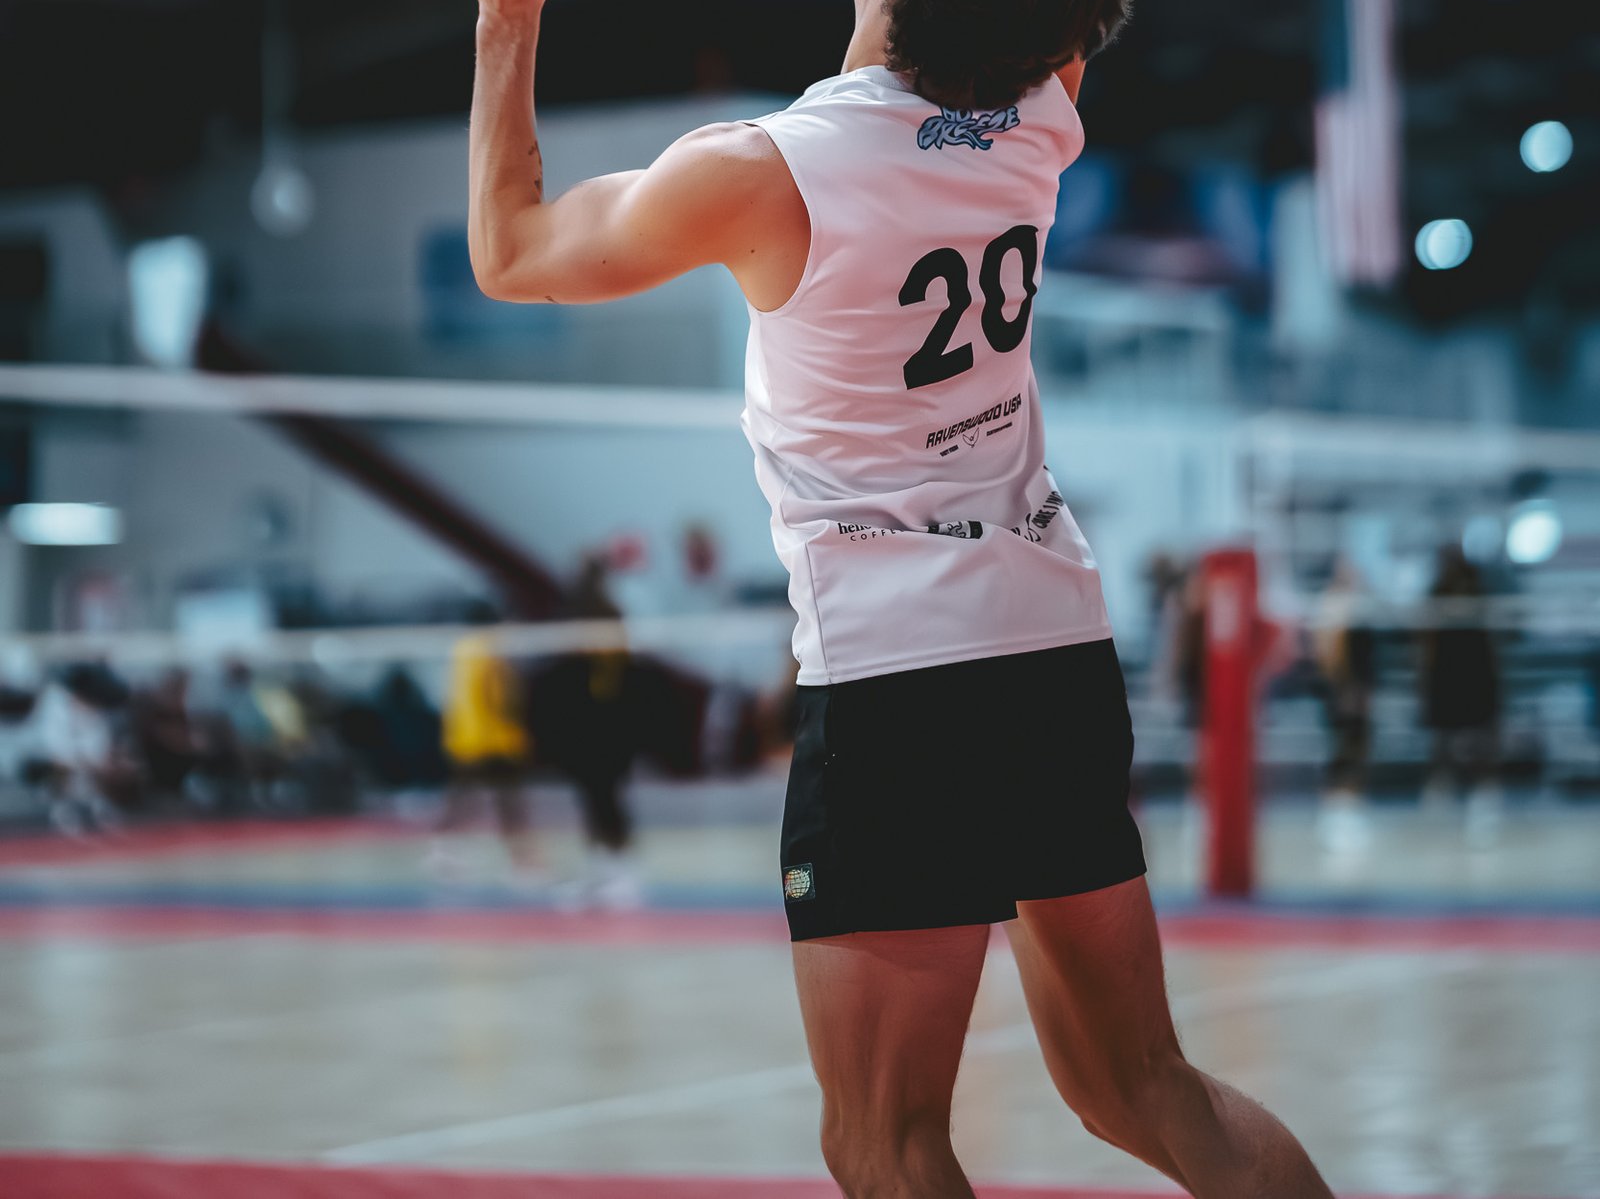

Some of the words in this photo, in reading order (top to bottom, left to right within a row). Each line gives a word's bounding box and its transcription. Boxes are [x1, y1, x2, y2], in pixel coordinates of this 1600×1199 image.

[898, 224, 1039, 390] 20
[1003, 393, 1022, 417] USA
[850, 529, 904, 541] COFFE
